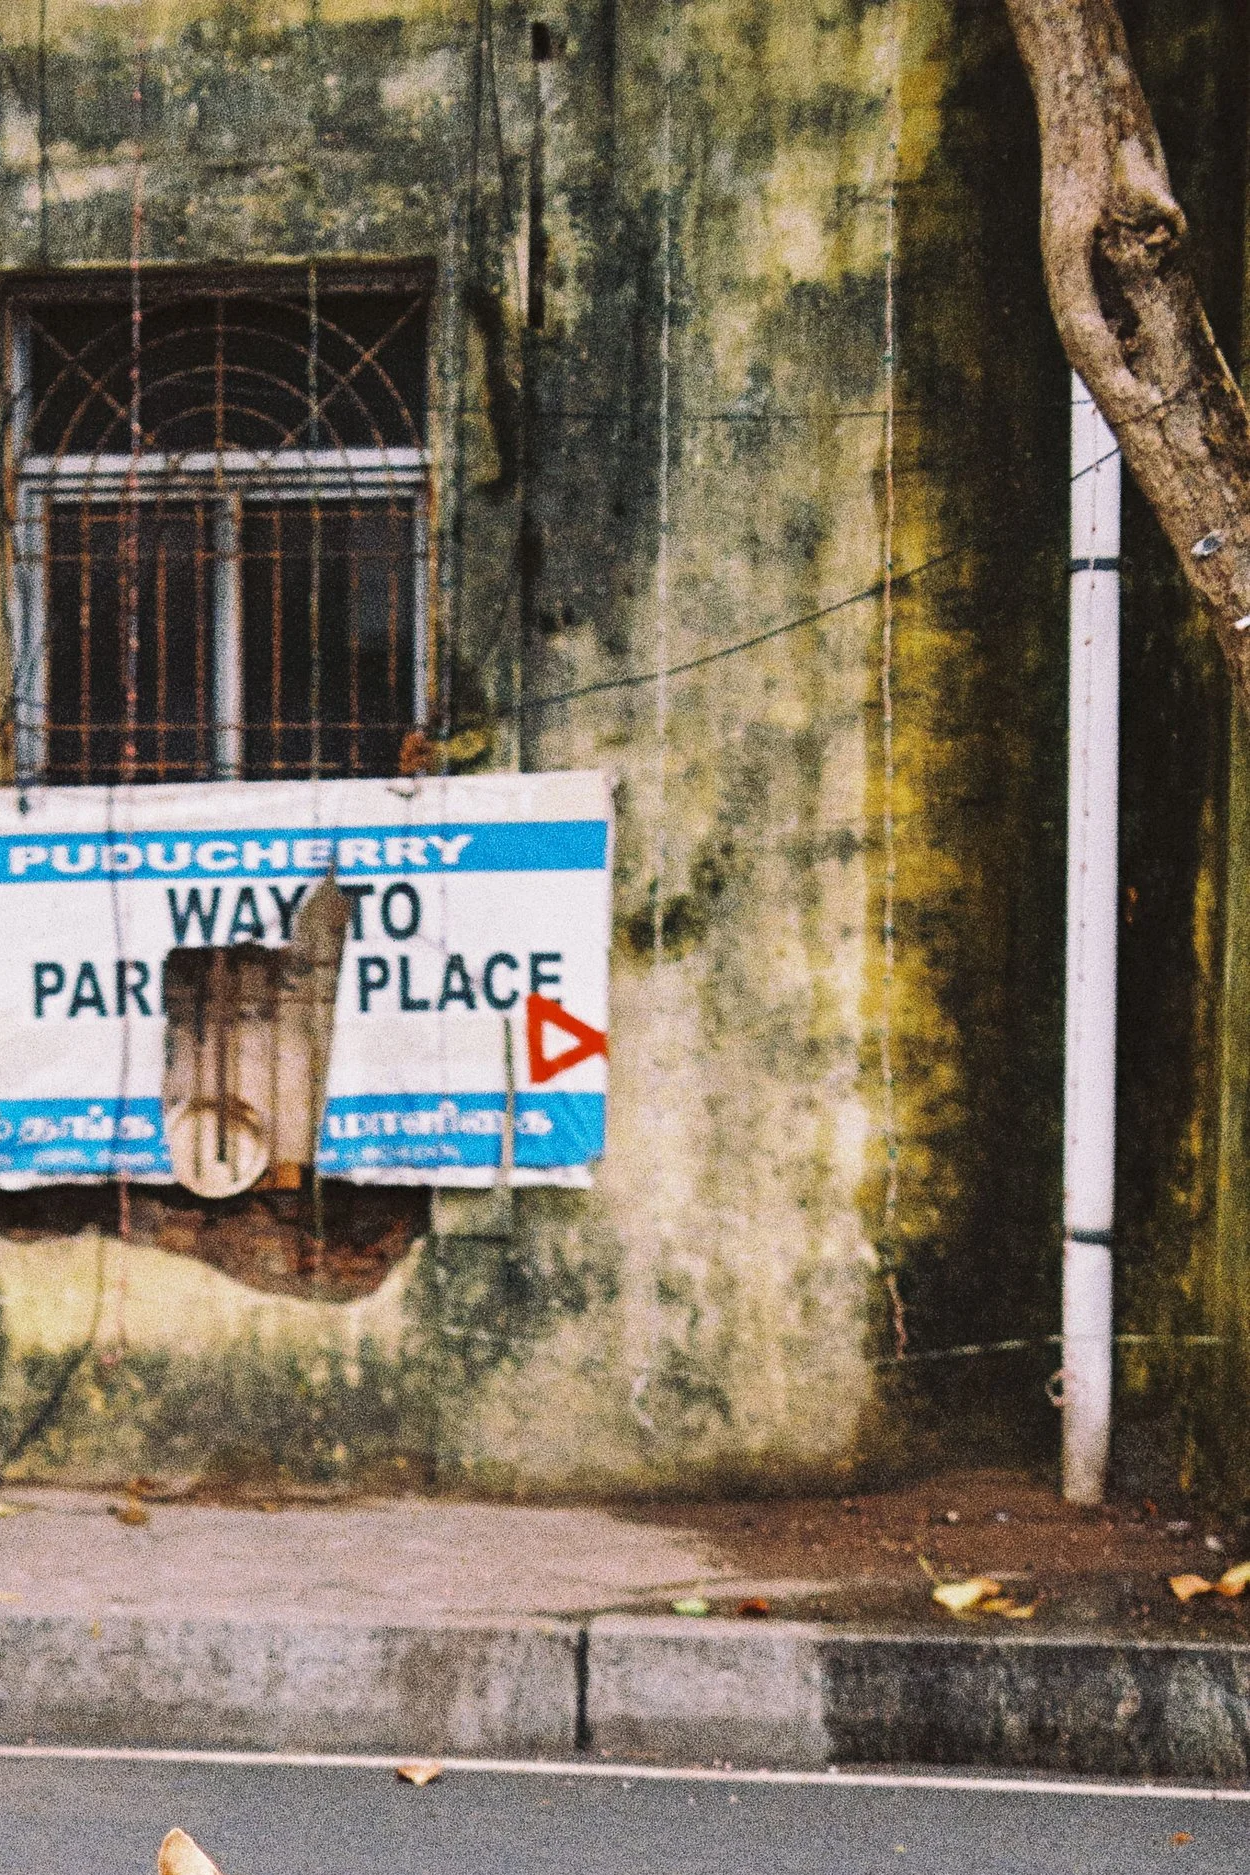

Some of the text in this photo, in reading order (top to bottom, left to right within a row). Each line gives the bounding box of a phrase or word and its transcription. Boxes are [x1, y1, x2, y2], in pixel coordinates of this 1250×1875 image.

[8, 834, 475, 876] PUDUCHERRY
[165, 881, 422, 946] WAY TO
[357, 951, 563, 1014] PLACE
